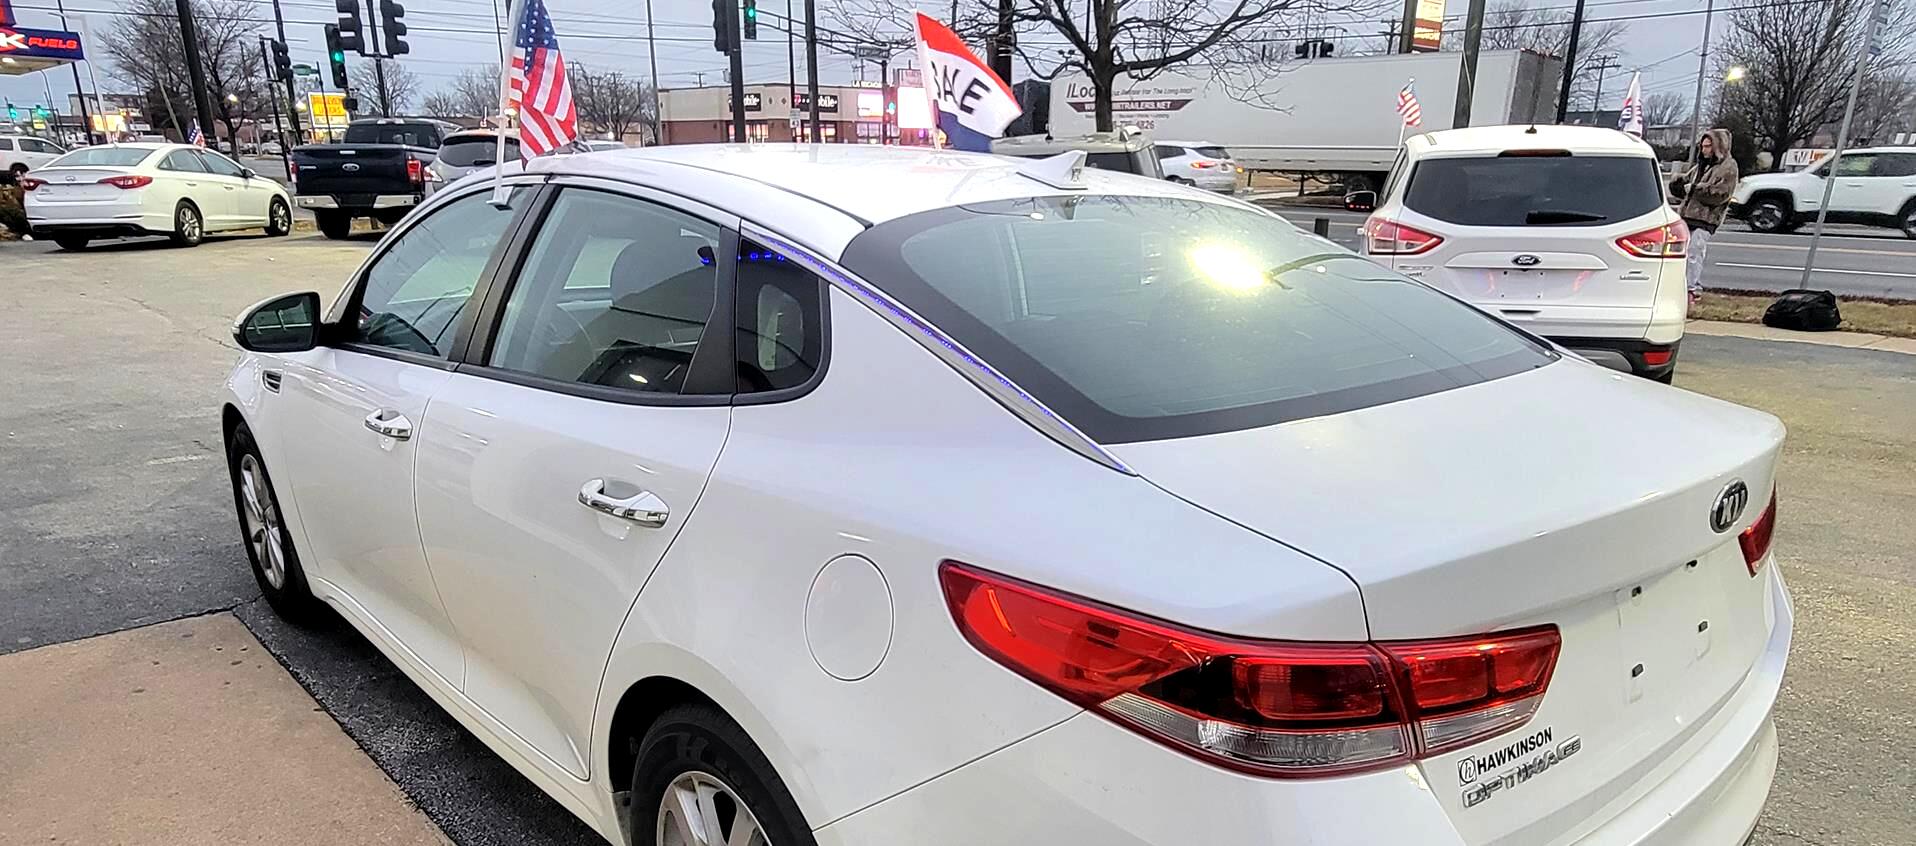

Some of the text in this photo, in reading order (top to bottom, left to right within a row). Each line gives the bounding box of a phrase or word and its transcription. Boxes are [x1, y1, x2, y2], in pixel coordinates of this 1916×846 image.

[28, 37, 77, 49] FUELS
[1066, 83, 1097, 98] ILoc
[1477, 727, 1552, 775] HAWKINSON
[1462, 750, 1560, 808] OPTIMA
